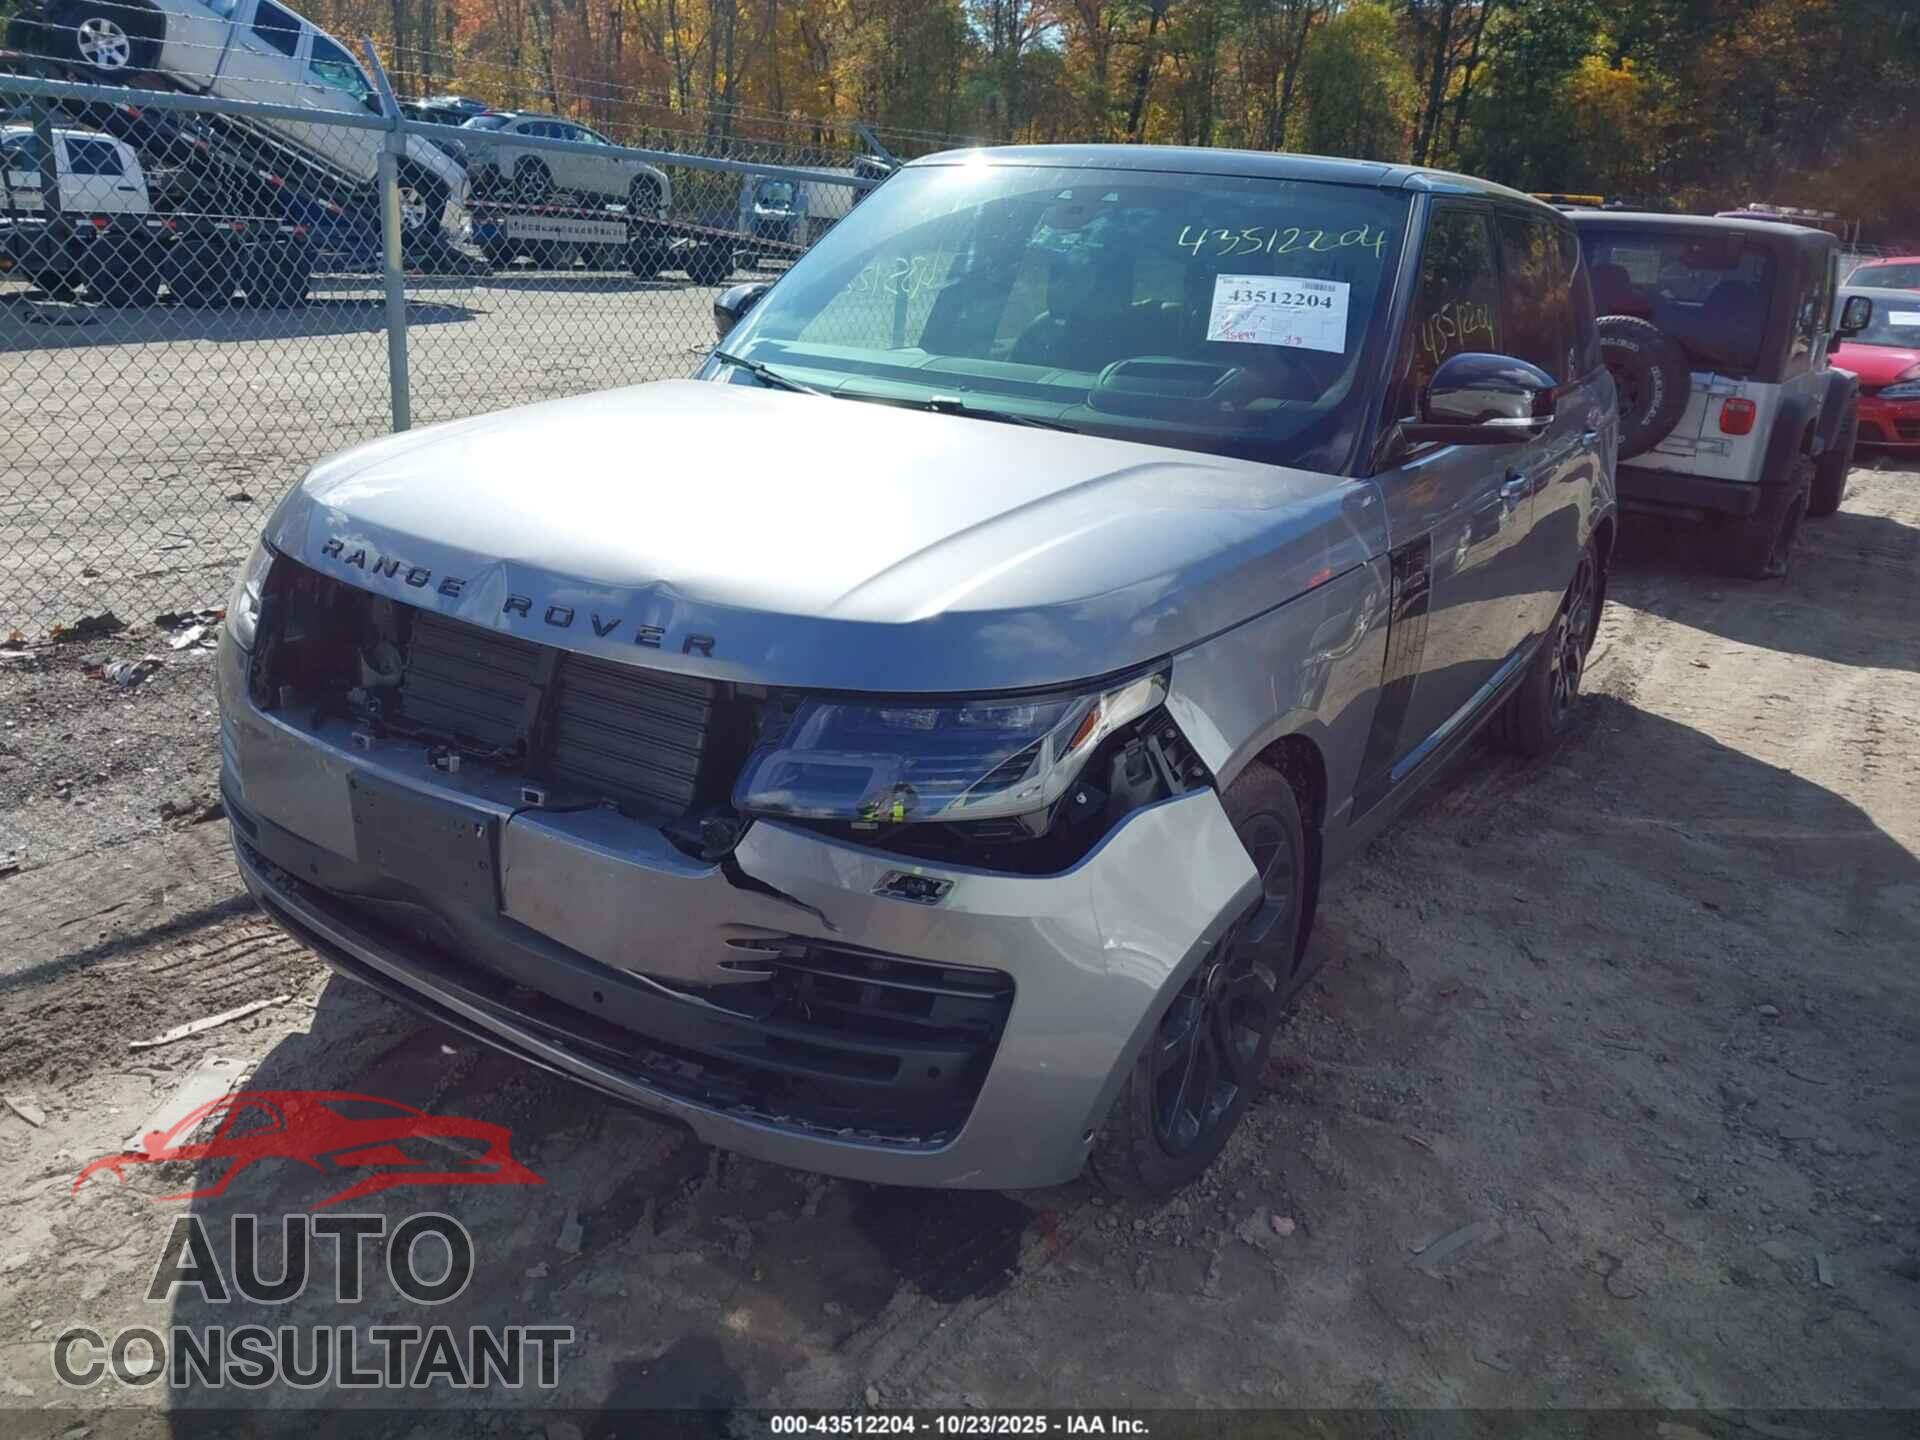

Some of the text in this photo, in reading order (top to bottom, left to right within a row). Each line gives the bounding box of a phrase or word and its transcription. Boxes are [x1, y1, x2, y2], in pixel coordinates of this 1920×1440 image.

[1178, 224, 1388, 259] 43512204
[1227, 288, 1333, 309] 43512204
[321, 537, 717, 658] RANGE ROVER
